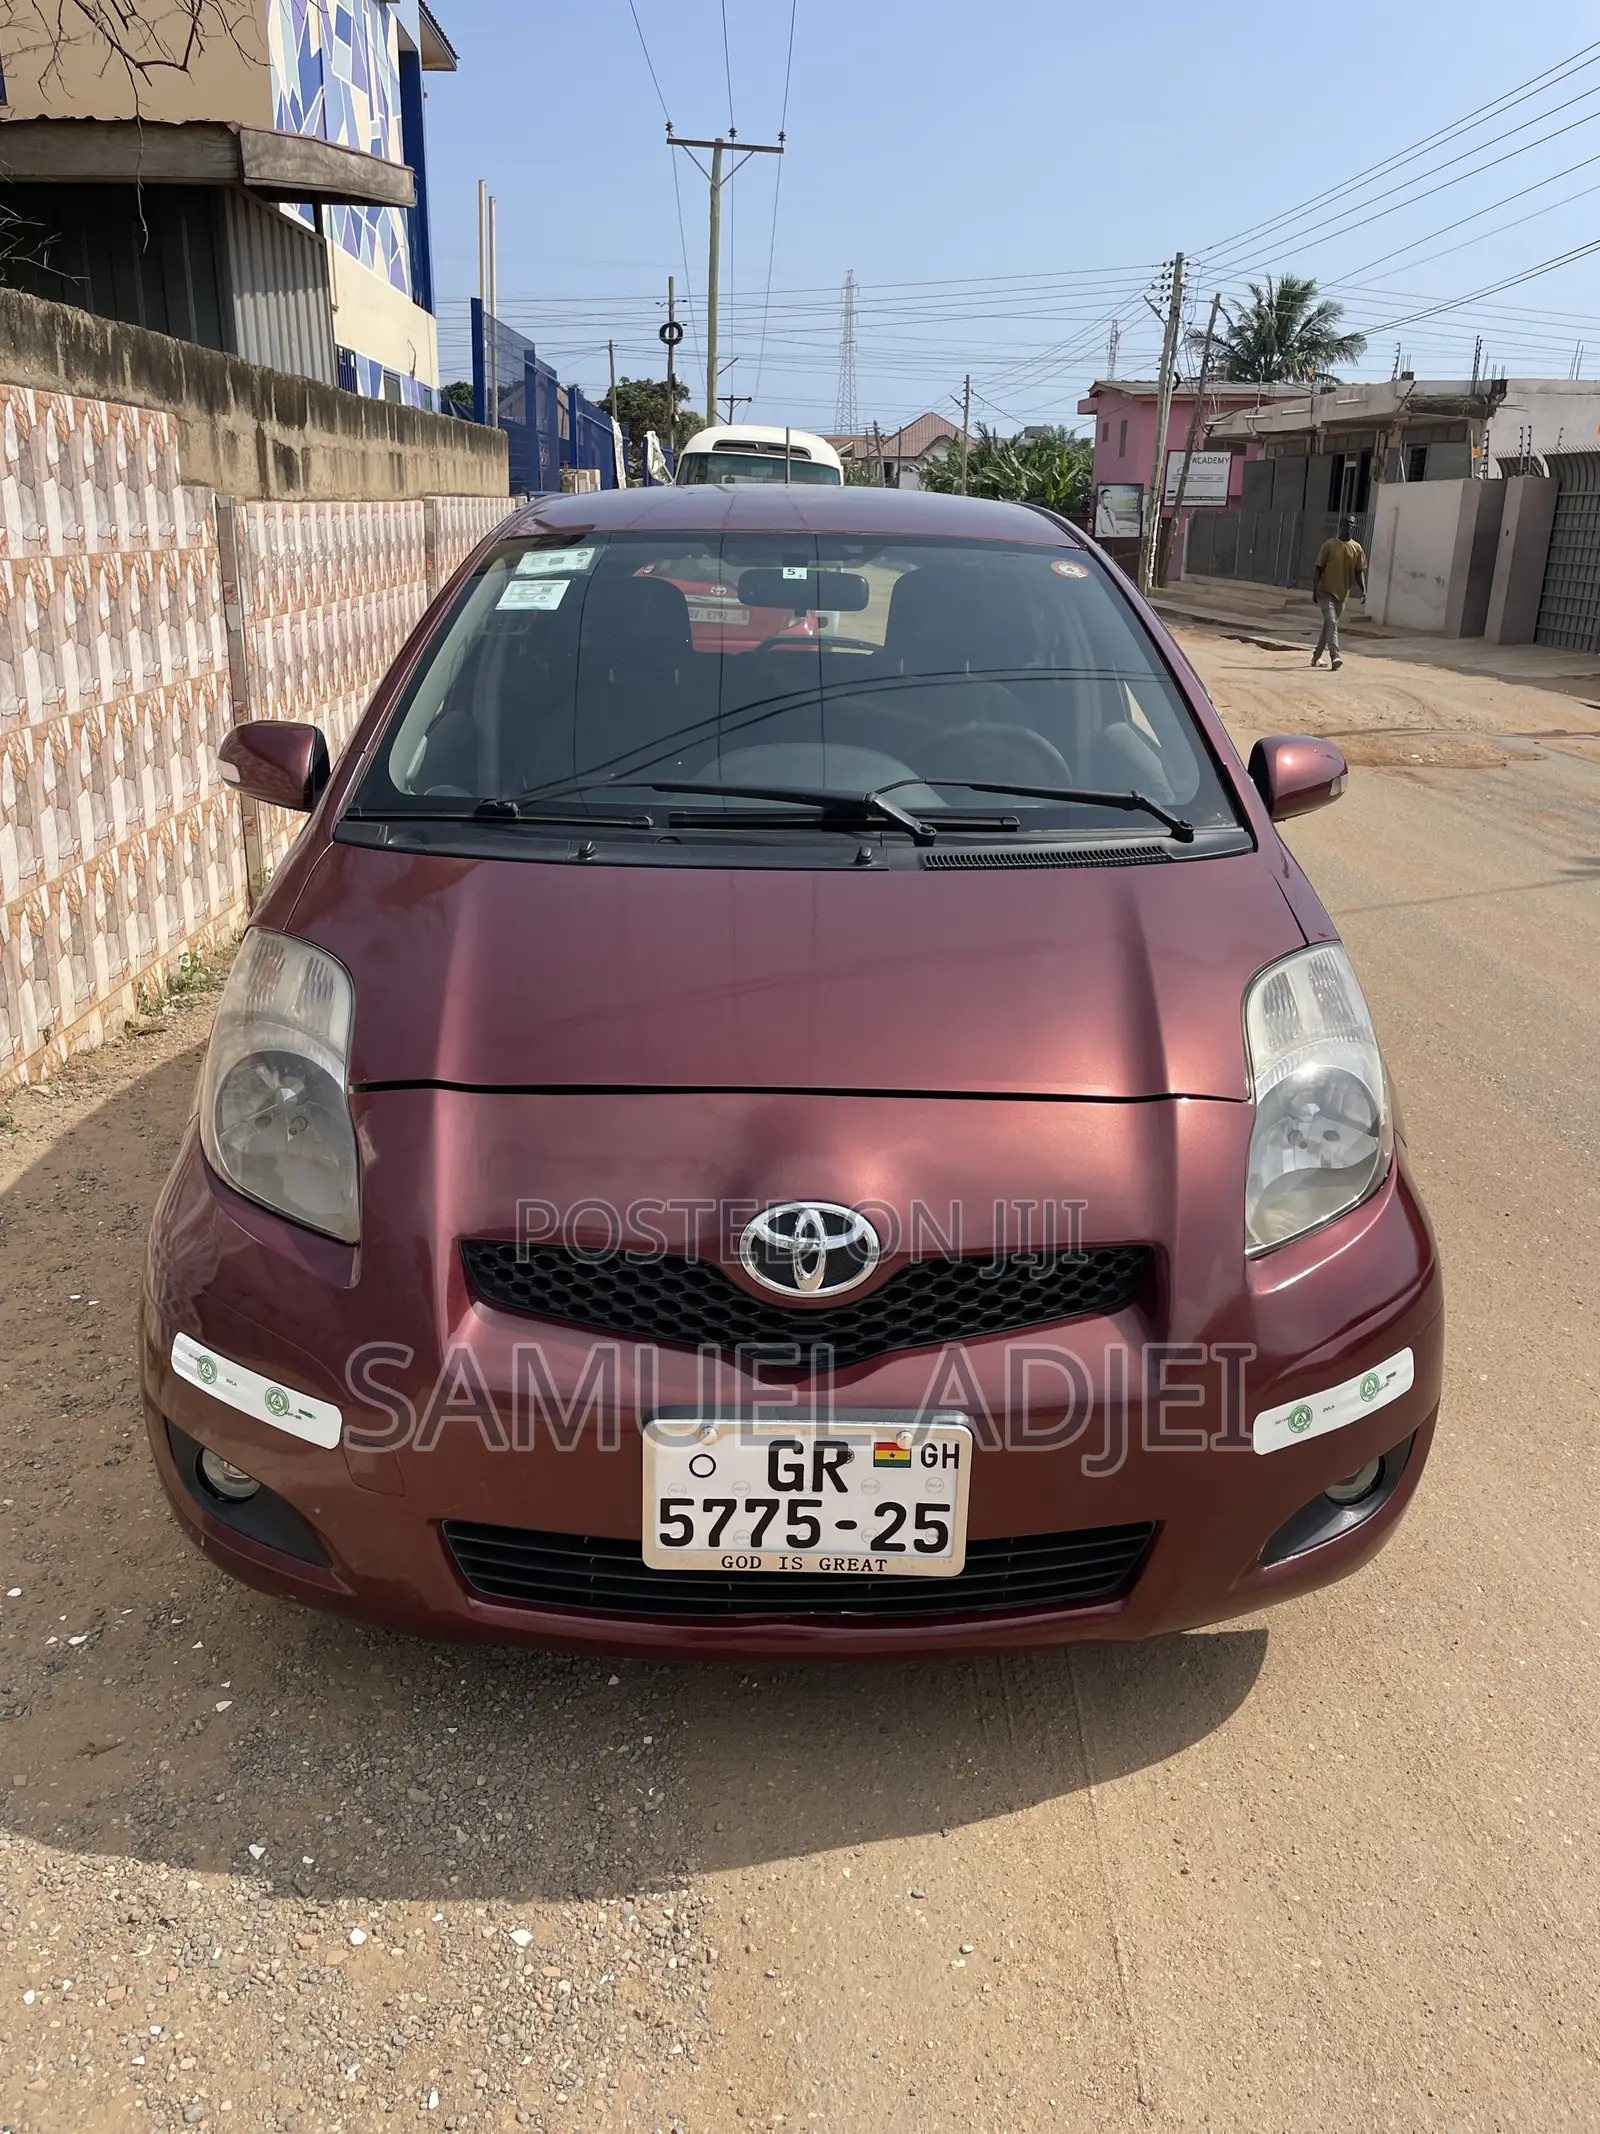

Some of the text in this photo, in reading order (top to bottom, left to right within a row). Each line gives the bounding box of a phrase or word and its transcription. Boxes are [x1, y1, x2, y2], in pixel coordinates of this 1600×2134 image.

[1192, 457, 1230, 465] ACADEMY
[767, 1440, 960, 1493] GR GH
[658, 1498, 951, 1554] 5775-25
[721, 1555, 888, 1573] GOD IS GREAT
